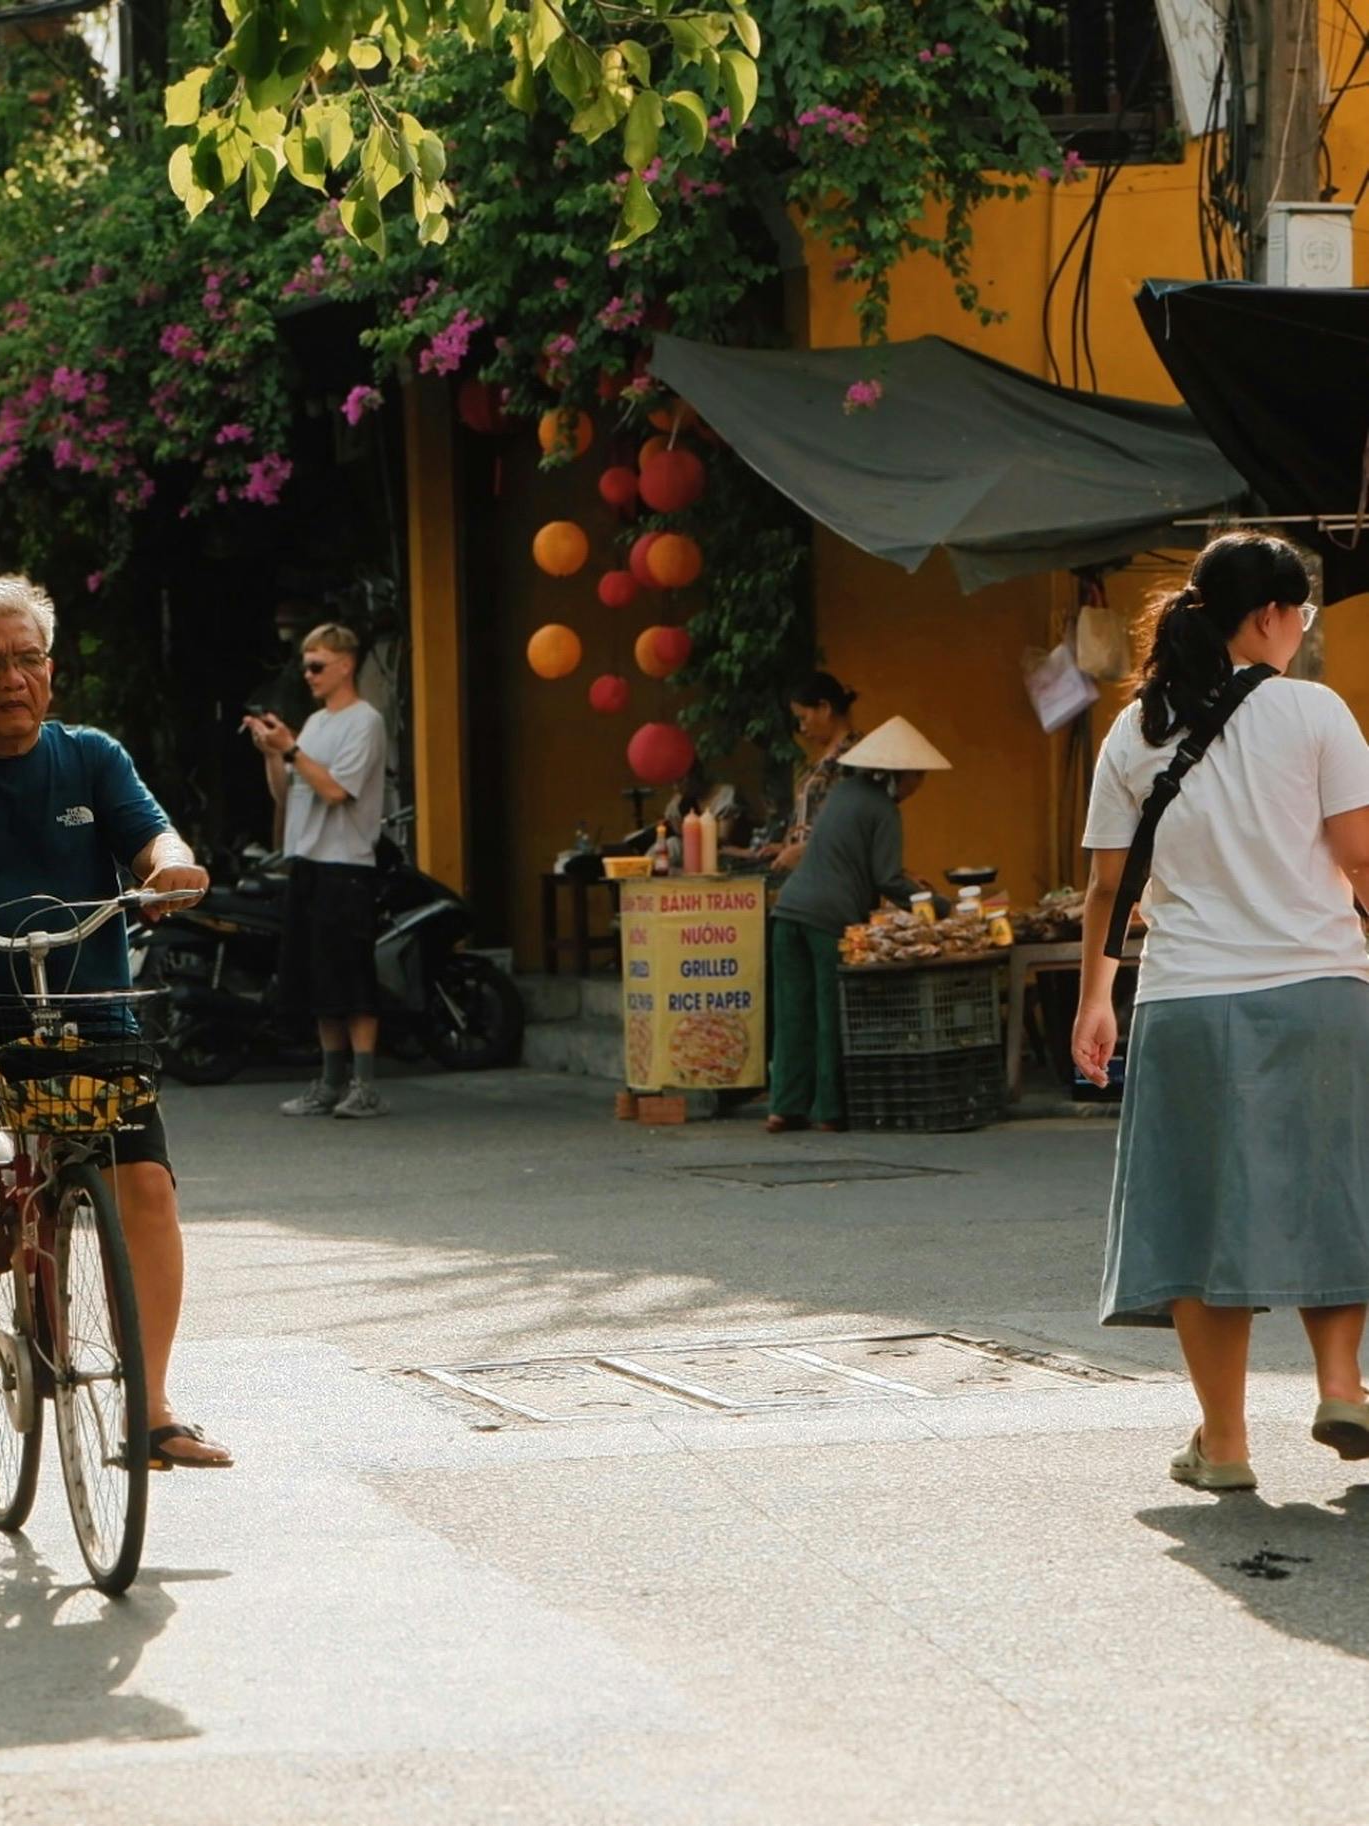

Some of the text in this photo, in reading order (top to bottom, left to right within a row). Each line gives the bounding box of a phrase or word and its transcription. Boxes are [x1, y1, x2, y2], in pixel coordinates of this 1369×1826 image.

[660, 889, 702, 912] BÁNH
[706, 888, 756, 910] TRÁNG
[680, 959, 738, 979] GRILLED
[668, 993, 702, 1012] RICE
[706, 991, 752, 1011] PAPER
